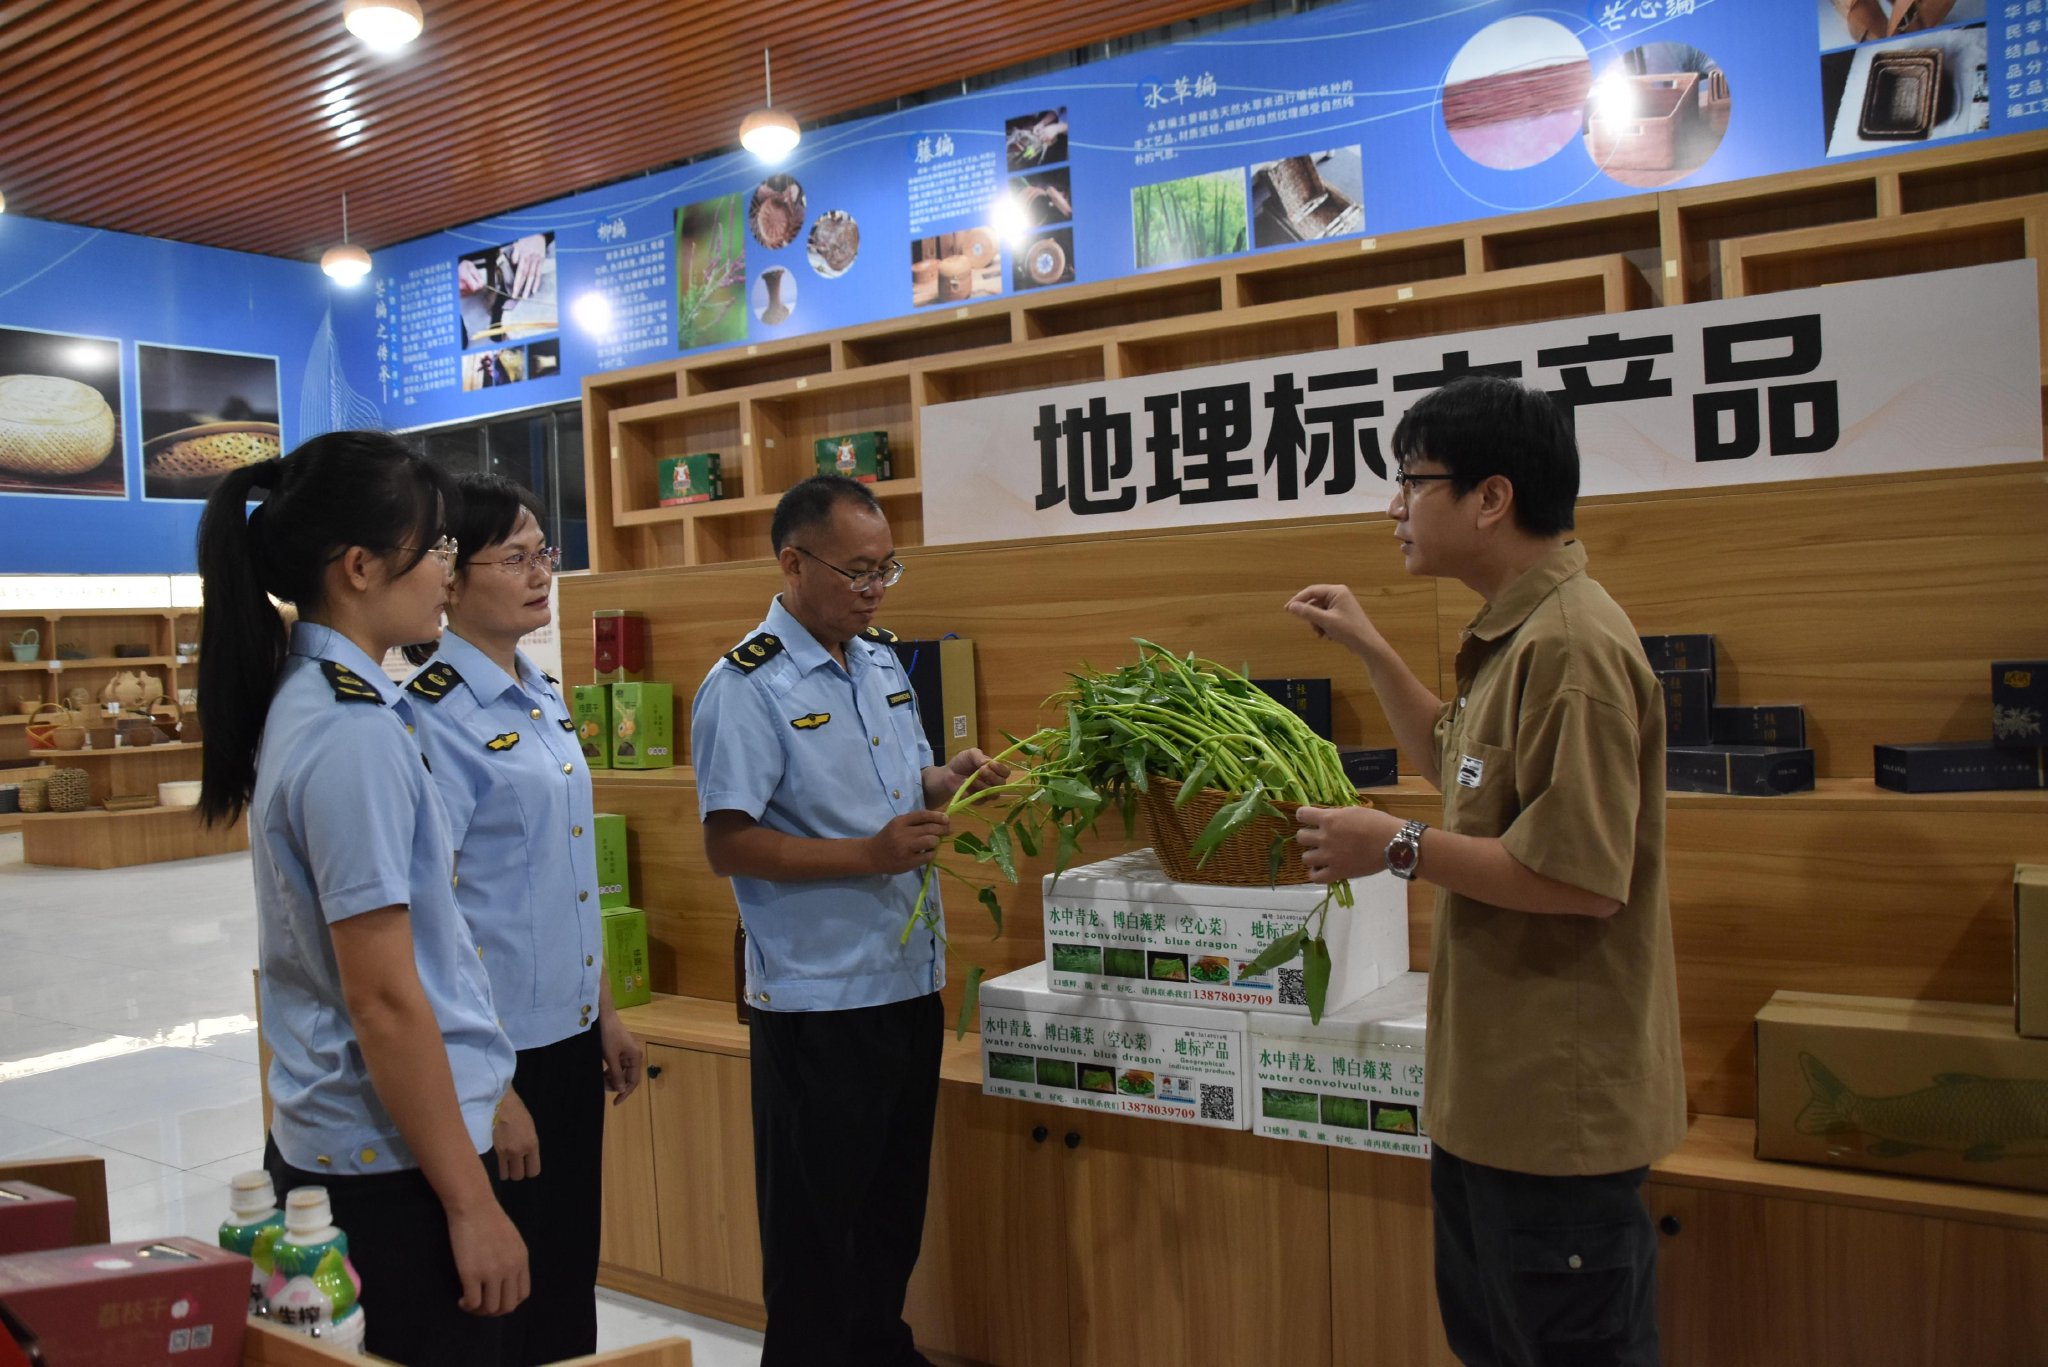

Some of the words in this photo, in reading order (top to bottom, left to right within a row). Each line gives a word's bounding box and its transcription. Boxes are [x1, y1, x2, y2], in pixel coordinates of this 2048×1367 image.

[1143, 72, 1217, 110] 水草编
[915, 132, 955, 164] 藤编
[1034, 314, 1841, 516] 地理标产品
[1049, 928, 1080, 938] water
[1084, 931, 1156, 945] convolvulus,
[1165, 936, 1192, 947] blue
[1195, 937, 1238, 950] dragon
[1193, 990, 1273, 1006] 13878039709
[985, 1038, 1013, 1048] water
[1018, 1041, 1087, 1057] convolvulus,
[1093, 1049, 1118, 1060] blue
[1122, 1053, 1162, 1065] dragon
[1258, 1072, 1293, 1083] water
[1298, 1076, 1383, 1094] convolvulus,
[1391, 1086, 1421, 1098] blue
[1120, 1101, 1196, 1119] 13878039709
